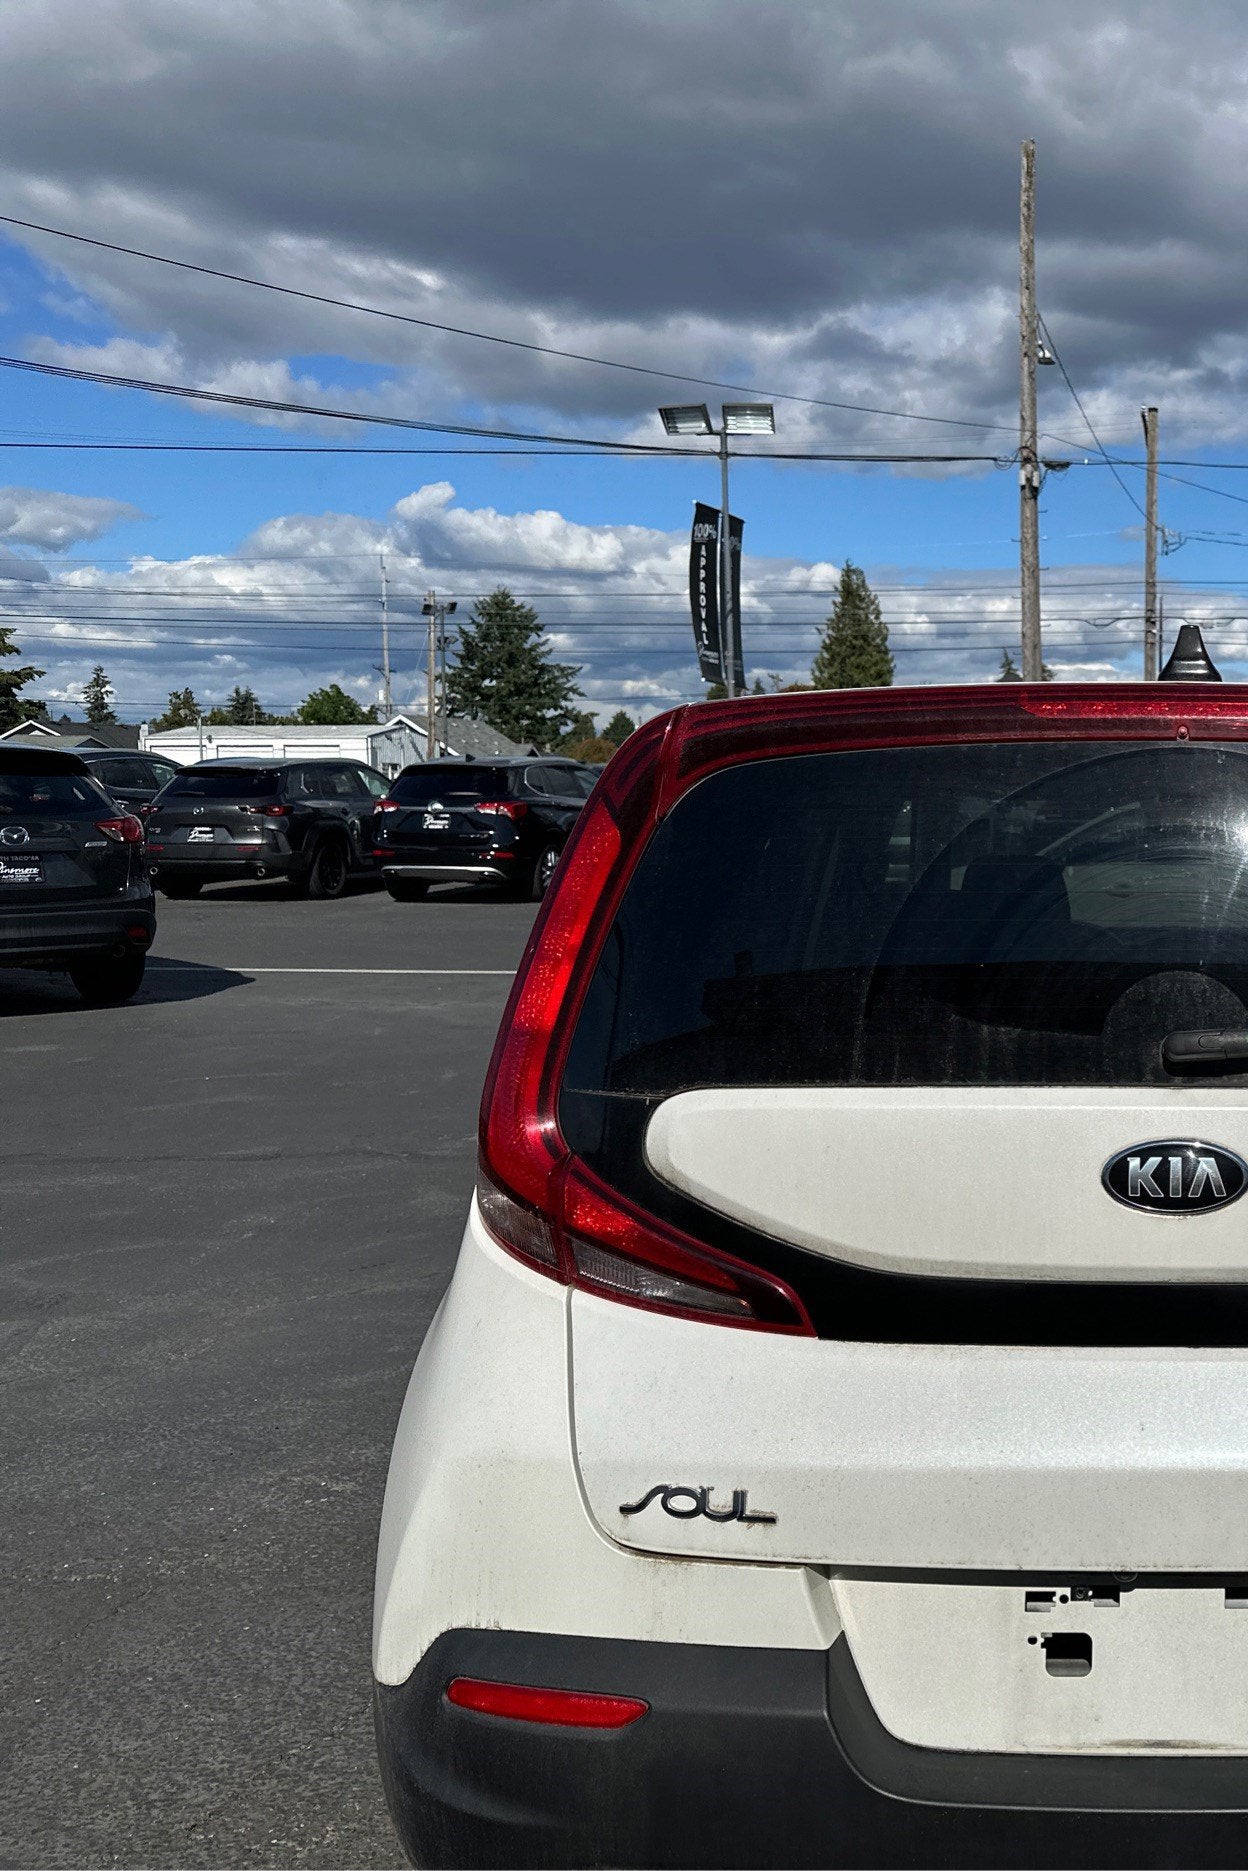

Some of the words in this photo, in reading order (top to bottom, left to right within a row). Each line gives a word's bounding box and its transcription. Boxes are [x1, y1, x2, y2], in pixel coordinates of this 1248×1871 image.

[693, 523, 717, 539] 100%
[699, 544, 709, 645] APPROVAL
[1126, 1156, 1227, 1198] KIA
[618, 1484, 778, 1524] SOUL
